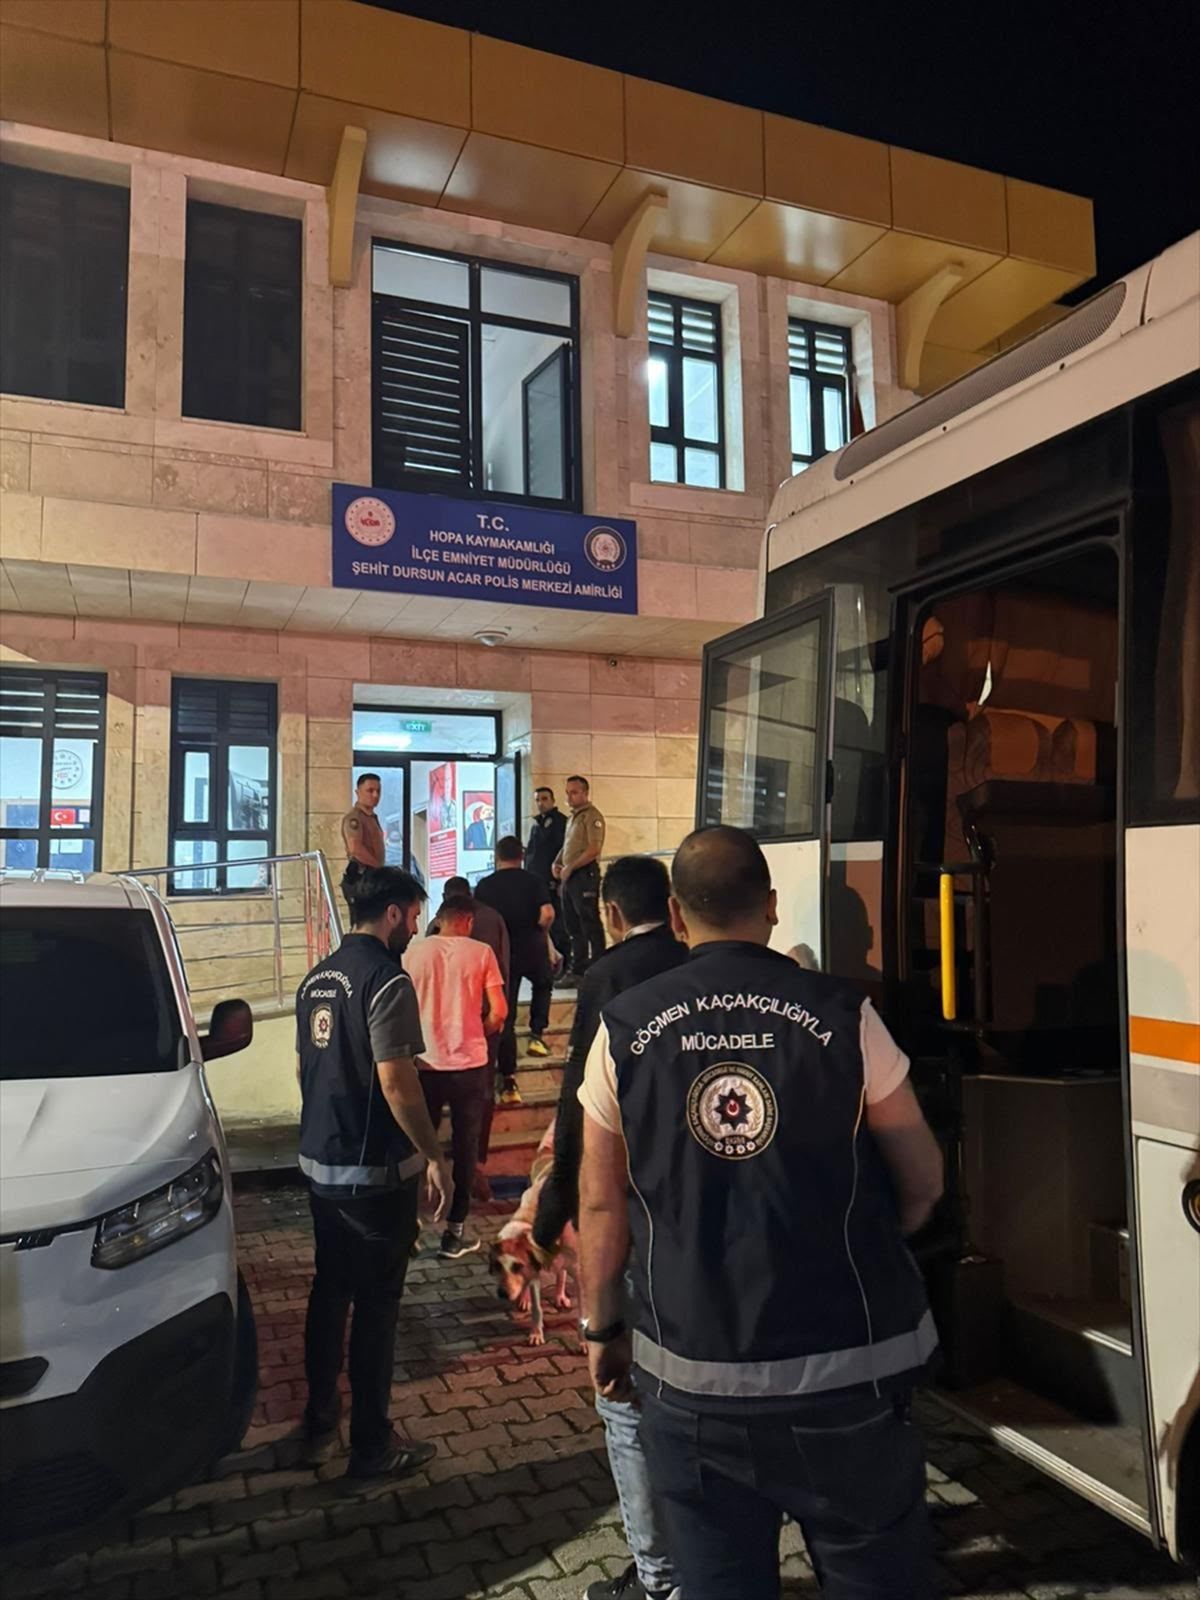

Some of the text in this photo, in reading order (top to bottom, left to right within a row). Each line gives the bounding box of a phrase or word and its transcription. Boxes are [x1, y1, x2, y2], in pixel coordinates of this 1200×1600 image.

[476, 513, 510, 532] T.C.
[429, 529, 555, 555] HOPA KAYMAKAMLIĞI
[411, 544, 572, 576] İLÇE EMNİYET MÜDÜRLÜĞÜ
[351, 560, 623, 599] ŞEHİT DURSUN ACAR POLİS MERKEZİ AMİRLİĞİ
[630, 993, 833, 1056] GÖÇMEN KAÇAKÇILIĞIYLA
[681, 1031, 775, 1051] MÜCADELE
